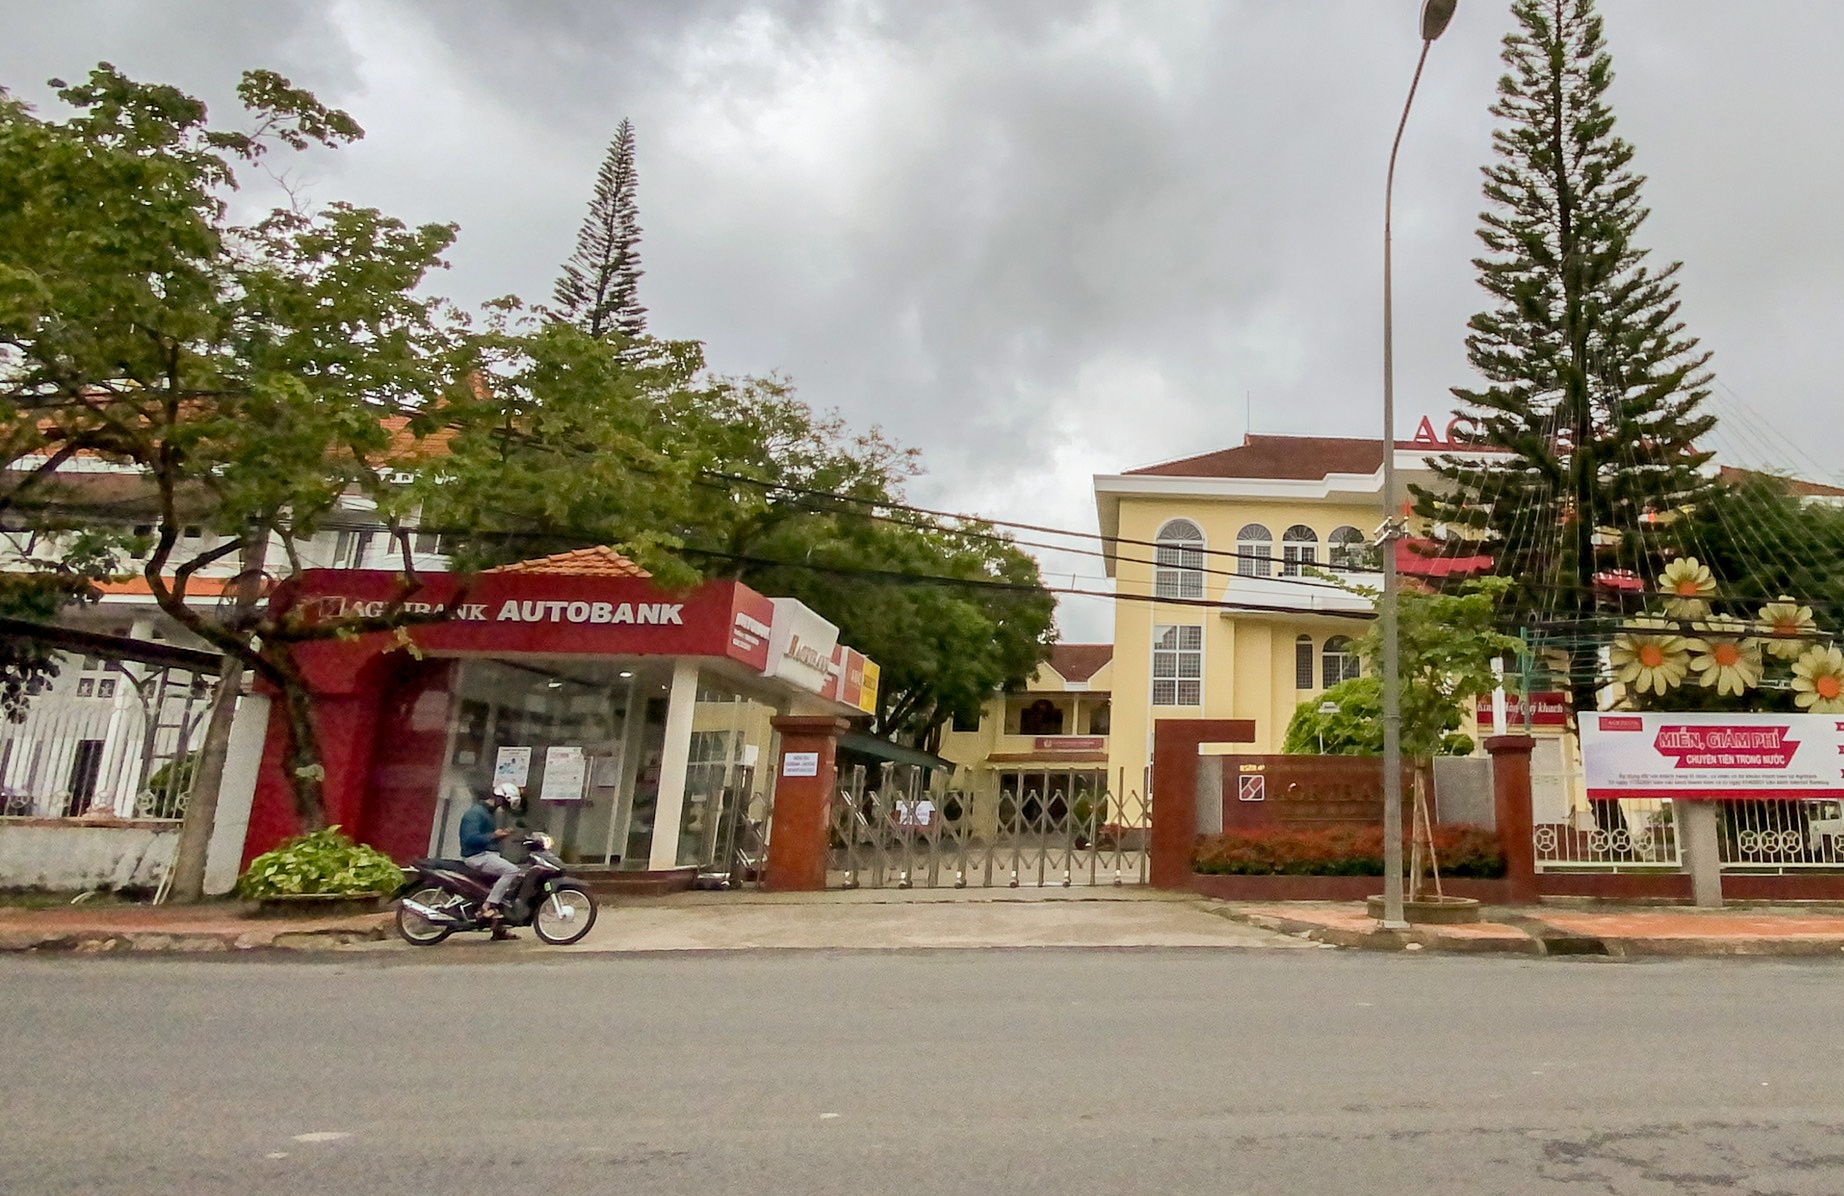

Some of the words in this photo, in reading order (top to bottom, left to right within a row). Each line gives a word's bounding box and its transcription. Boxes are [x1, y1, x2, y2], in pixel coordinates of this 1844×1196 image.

[496, 600, 684, 625] AUTOBANK
[1751, 728, 1780, 749] PHÍ
[1735, 755, 1762, 765] TRONG
